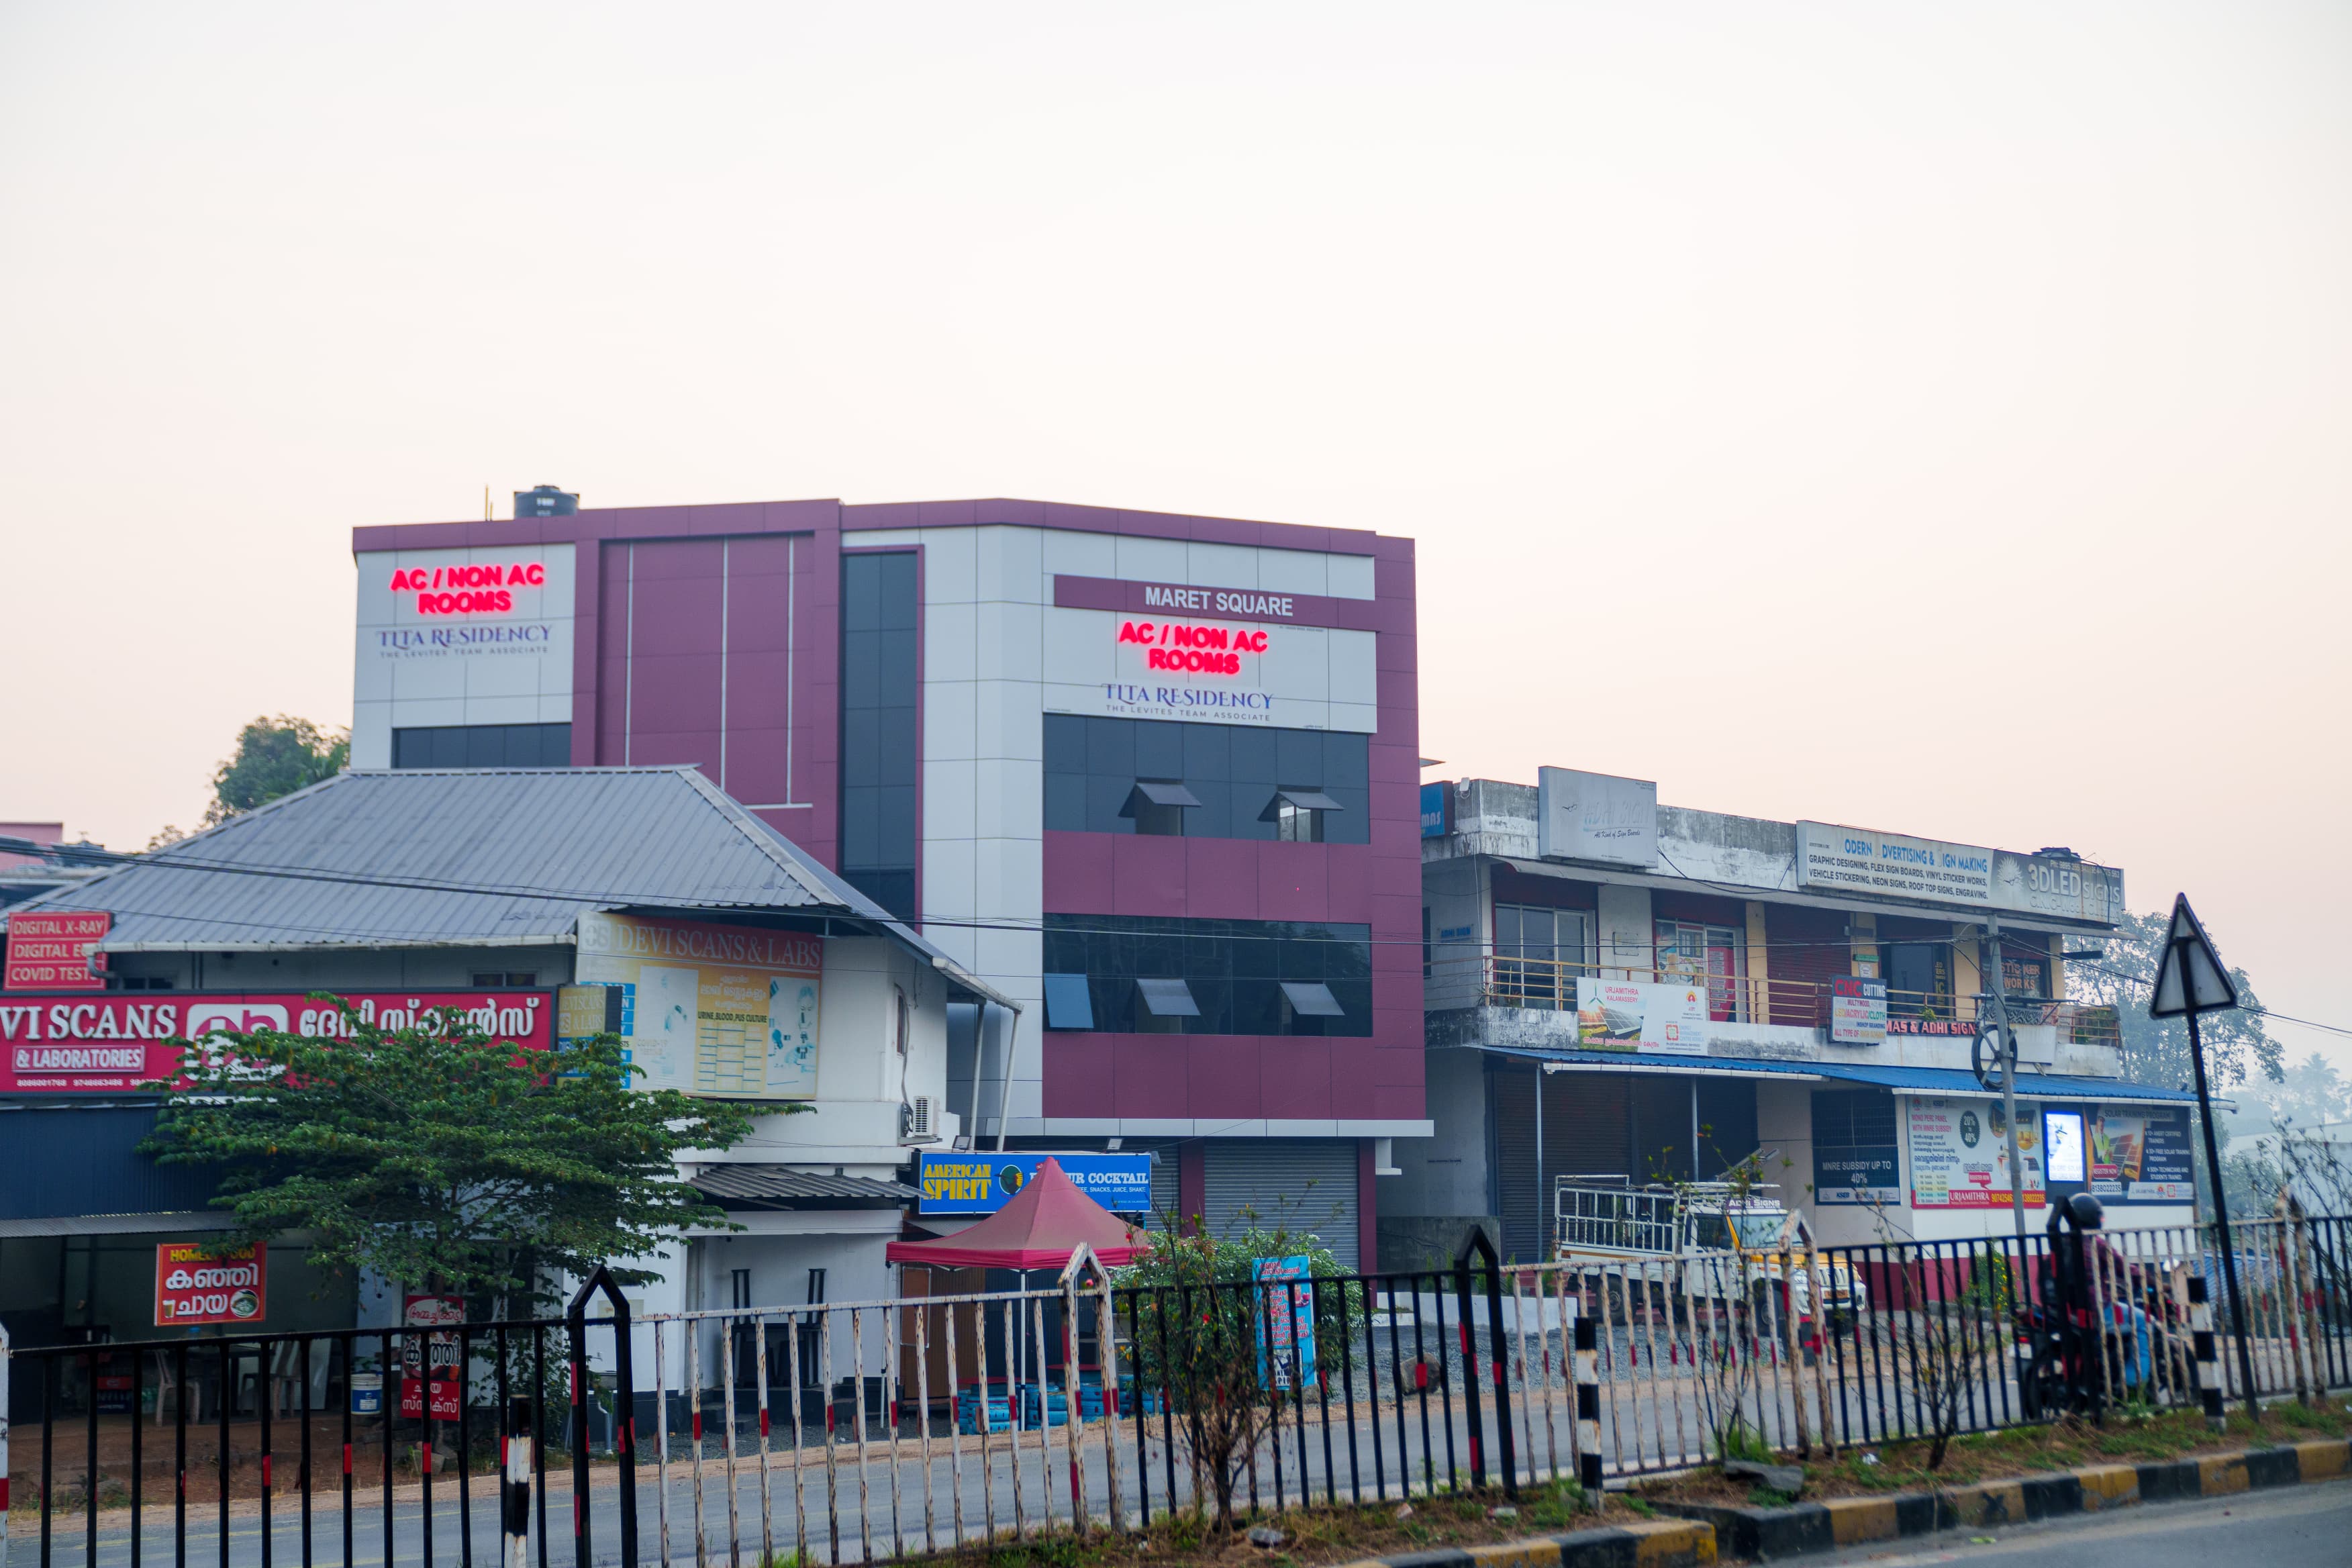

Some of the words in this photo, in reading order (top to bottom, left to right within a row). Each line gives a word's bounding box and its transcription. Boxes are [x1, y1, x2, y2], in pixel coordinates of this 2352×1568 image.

[391, 569, 427, 591] AC
[433, 569, 442, 589] /
[448, 565, 502, 588] NON
[507, 564, 544, 585] AC
[418, 591, 511, 614] ROOMS
[1145, 586, 1211, 609] MARET
[1216, 592, 1293, 616] SQUARE
[432, 624, 552, 648] RESIDENCY
[1119, 622, 1155, 644] AC
[1161, 624, 1169, 644] /
[1175, 625, 1227, 649] NON
[1233, 631, 1268, 652] AC
[455, 648, 482, 656] TEAM
[490, 646, 548, 654] ASSOCIATE
[1148, 648, 1240, 675] ROOMS
[1157, 687, 1273, 709] RESIDENCY
[1131, 707, 1172, 716] LEVITES
[1180, 709, 1207, 718] TEAM
[1214, 712, 1271, 722] ASSOCIATE
[1843, 838, 1873, 856] ODERN
[1881, 844, 1926, 865] DVERTISING
[1929, 851, 1934, 866] &
[1958, 856, 1988, 873] MAKING
[1809, 854, 1835, 866] GRAPHIC
[1836, 858, 1869, 871] DESIGNING,
[1871, 863, 1884, 873] FLEX
[1885, 865, 1899, 874] SIGN
[1900, 867, 1924, 879] BOARDS,
[1926, 871, 1942, 881] VINYL
[1943, 873, 1965, 883] STICKER
[1967, 876, 1988, 887] WORKS,
[1809, 869, 1834, 879] VEHICLE
[1835, 872, 1871, 885] STICKERING,
[1872, 877, 1888, 887] NEON
[1890, 879, 1908, 890] SIGNS,
[1909, 881, 1924, 891] ROOF
[1926, 884, 1936, 893] TOP
[1937, 885, 1955, 897] SIGNS,
[1956, 888, 1988, 900] ENGRAVING.
[2083, 881, 2120, 904] SIGNS
[13, 921, 62, 934] DIGITAL
[65, 920, 105, 934] X-RAY
[15, 944, 68, 958] DIGITAL
[617, 924, 672, 954] DEVI
[676, 929, 745, 962] SCANS
[747, 936, 763, 963] &
[767, 938, 822, 968] LABS
[11, 968, 55, 981] COVID
[1605, 986, 1638, 995] URJAMITHRA
[1834, 979, 1862, 997] CNC
[1863, 983, 1885, 997] CUTTING
[1606, 995, 1638, 1003] KALAMASSERY
[48, 1004, 177, 1040] SCANS
[746, 1014, 768, 1024] CULTURE
[1843, 1028, 1853, 1037] TYPE
[1910, 1021, 1918, 1033] &
[1921, 1022, 1947, 1034] ADHI
[15, 1049, 30, 1069] &
[33, 1048, 142, 1069] LABORATORIES
[1935, 1115, 1947, 1123] PANEL
[2104, 1109, 2122, 1118] SOLAR
[1965, 1132, 1976, 1142] 40%
[923, 1165, 991, 1178] AMERICAN
[1822, 1161, 1840, 1171] MNRE
[1842, 1161, 1869, 1170] SUBSIDY
[1871, 1161, 1880, 1169] UP
[1883, 1161, 1891, 1169] TO
[1088, 1173, 1149, 1184] COCKTAIL
[1851, 1173, 1867, 1183] 40%
[922, 1179, 991, 1200] SPIRIT
[1950, 1191, 1990, 1202] URJAMITHRA
[166, 1263, 258, 1289] കഞ്ഞി
[176, 1294, 228, 1316] ചായ
